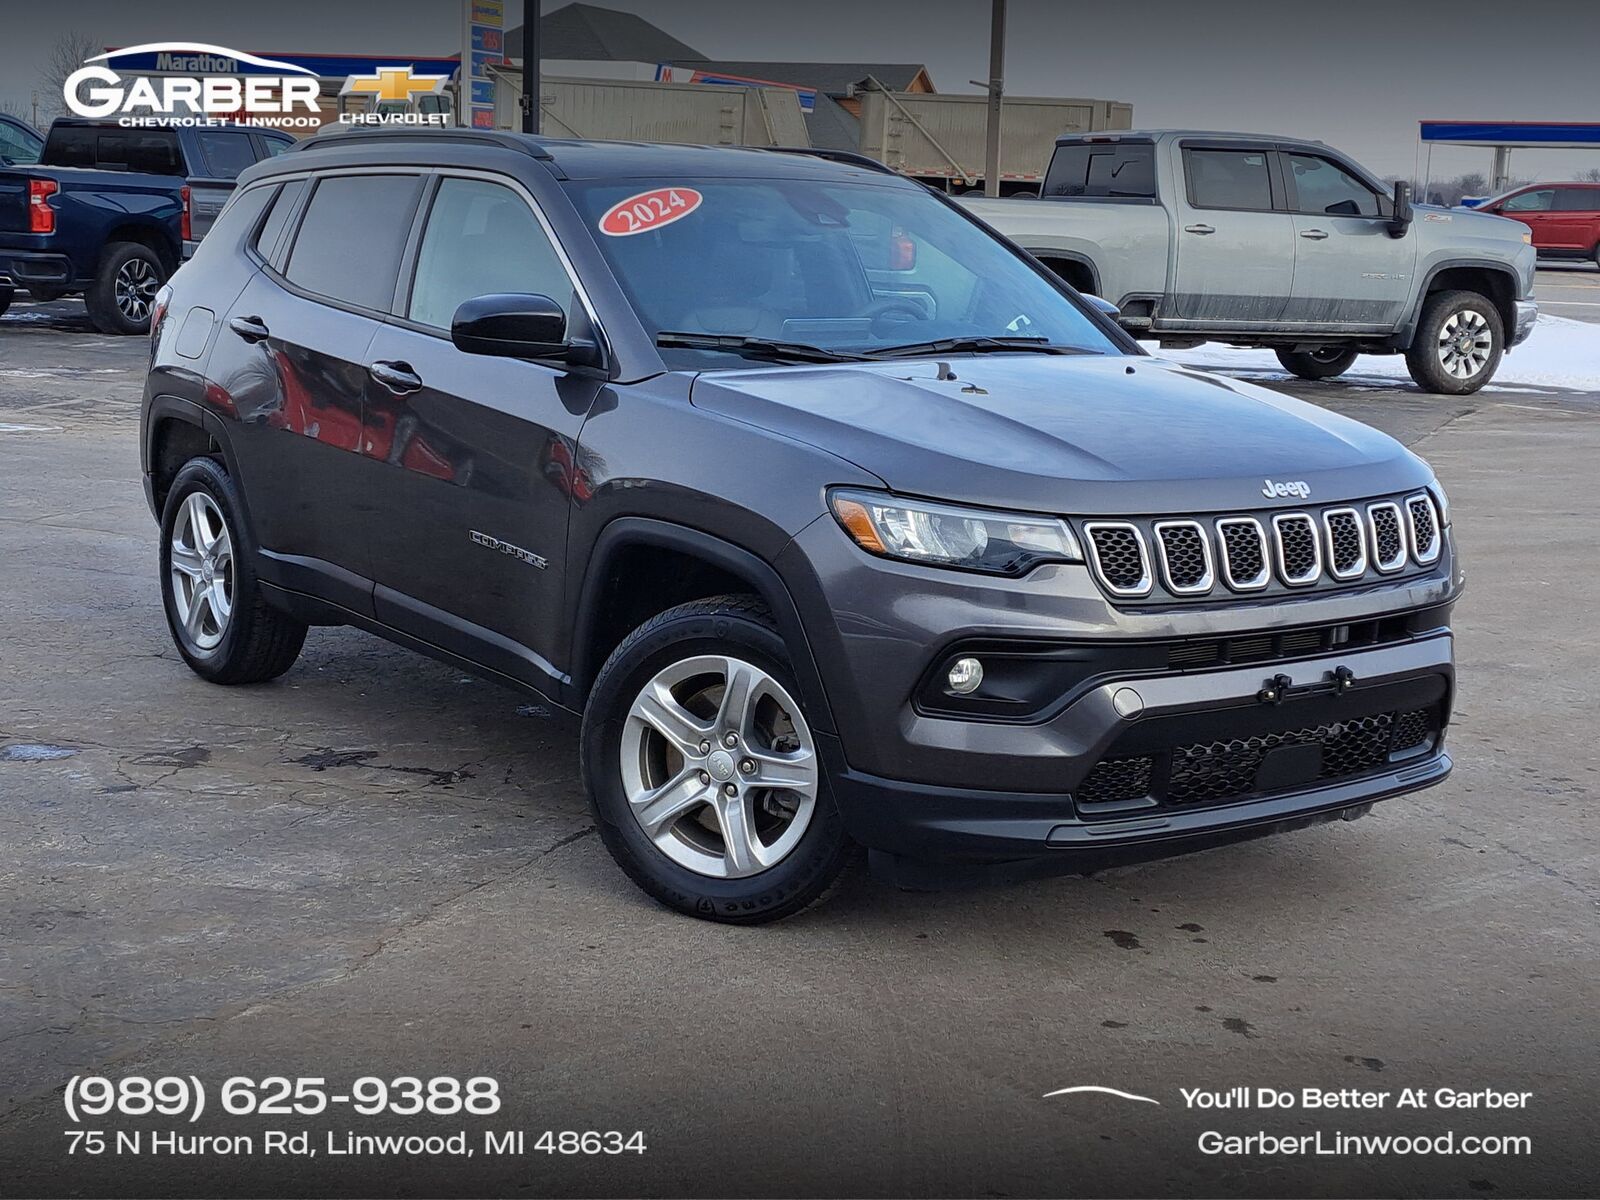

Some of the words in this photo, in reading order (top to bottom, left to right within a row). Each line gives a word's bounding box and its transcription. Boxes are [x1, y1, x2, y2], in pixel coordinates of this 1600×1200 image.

[156, 53, 238, 73] Marathon
[617, 189, 687, 232] 2024
[1261, 479, 1312, 499] Jeep
[468, 529, 549, 571] COMPASS
